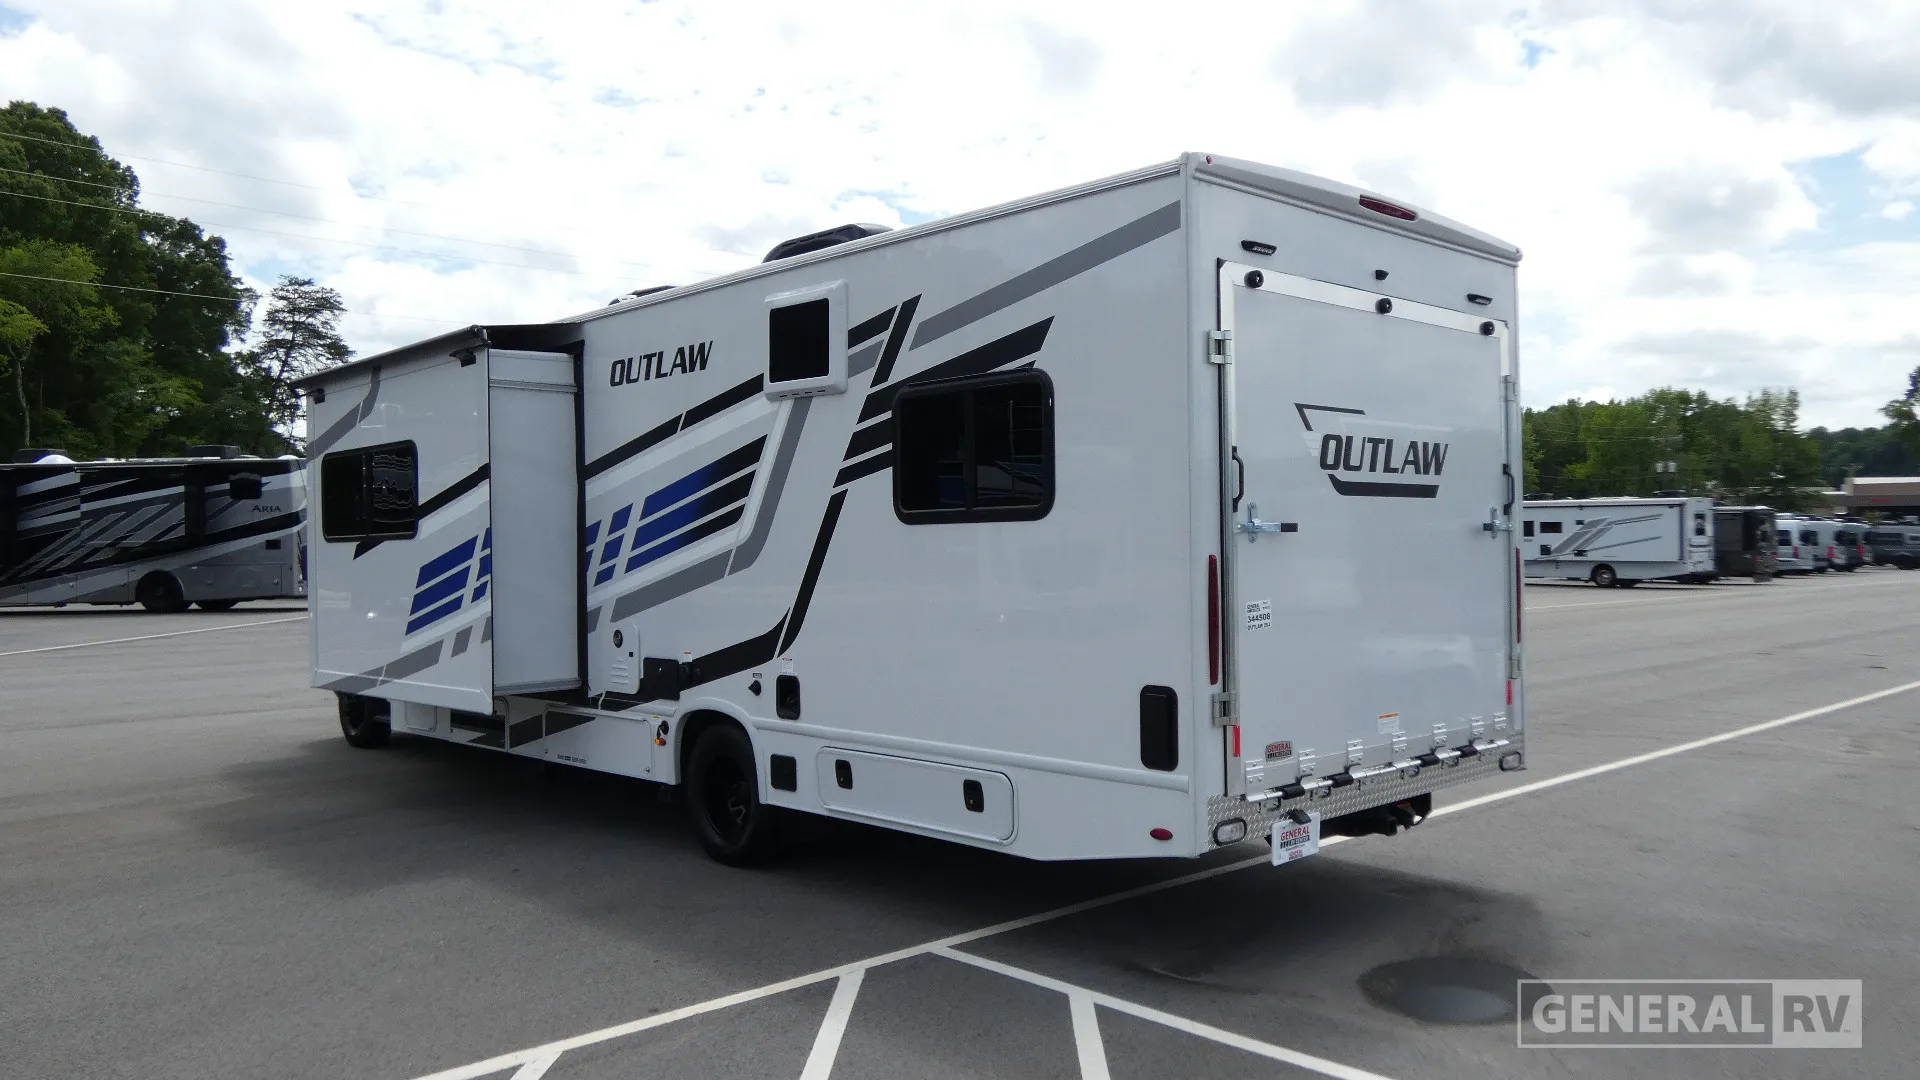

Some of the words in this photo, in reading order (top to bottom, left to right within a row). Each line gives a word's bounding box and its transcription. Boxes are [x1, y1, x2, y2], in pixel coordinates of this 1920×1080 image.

[610, 340, 714, 387] OUTLAW
[1319, 433, 1449, 476] OUTLAW
[252, 504, 281, 513] ARIA
[1247, 613, 1271, 623] 344508
[1267, 743, 1292, 753] GENERAL
[1281, 826, 1310, 841] GENERAL
